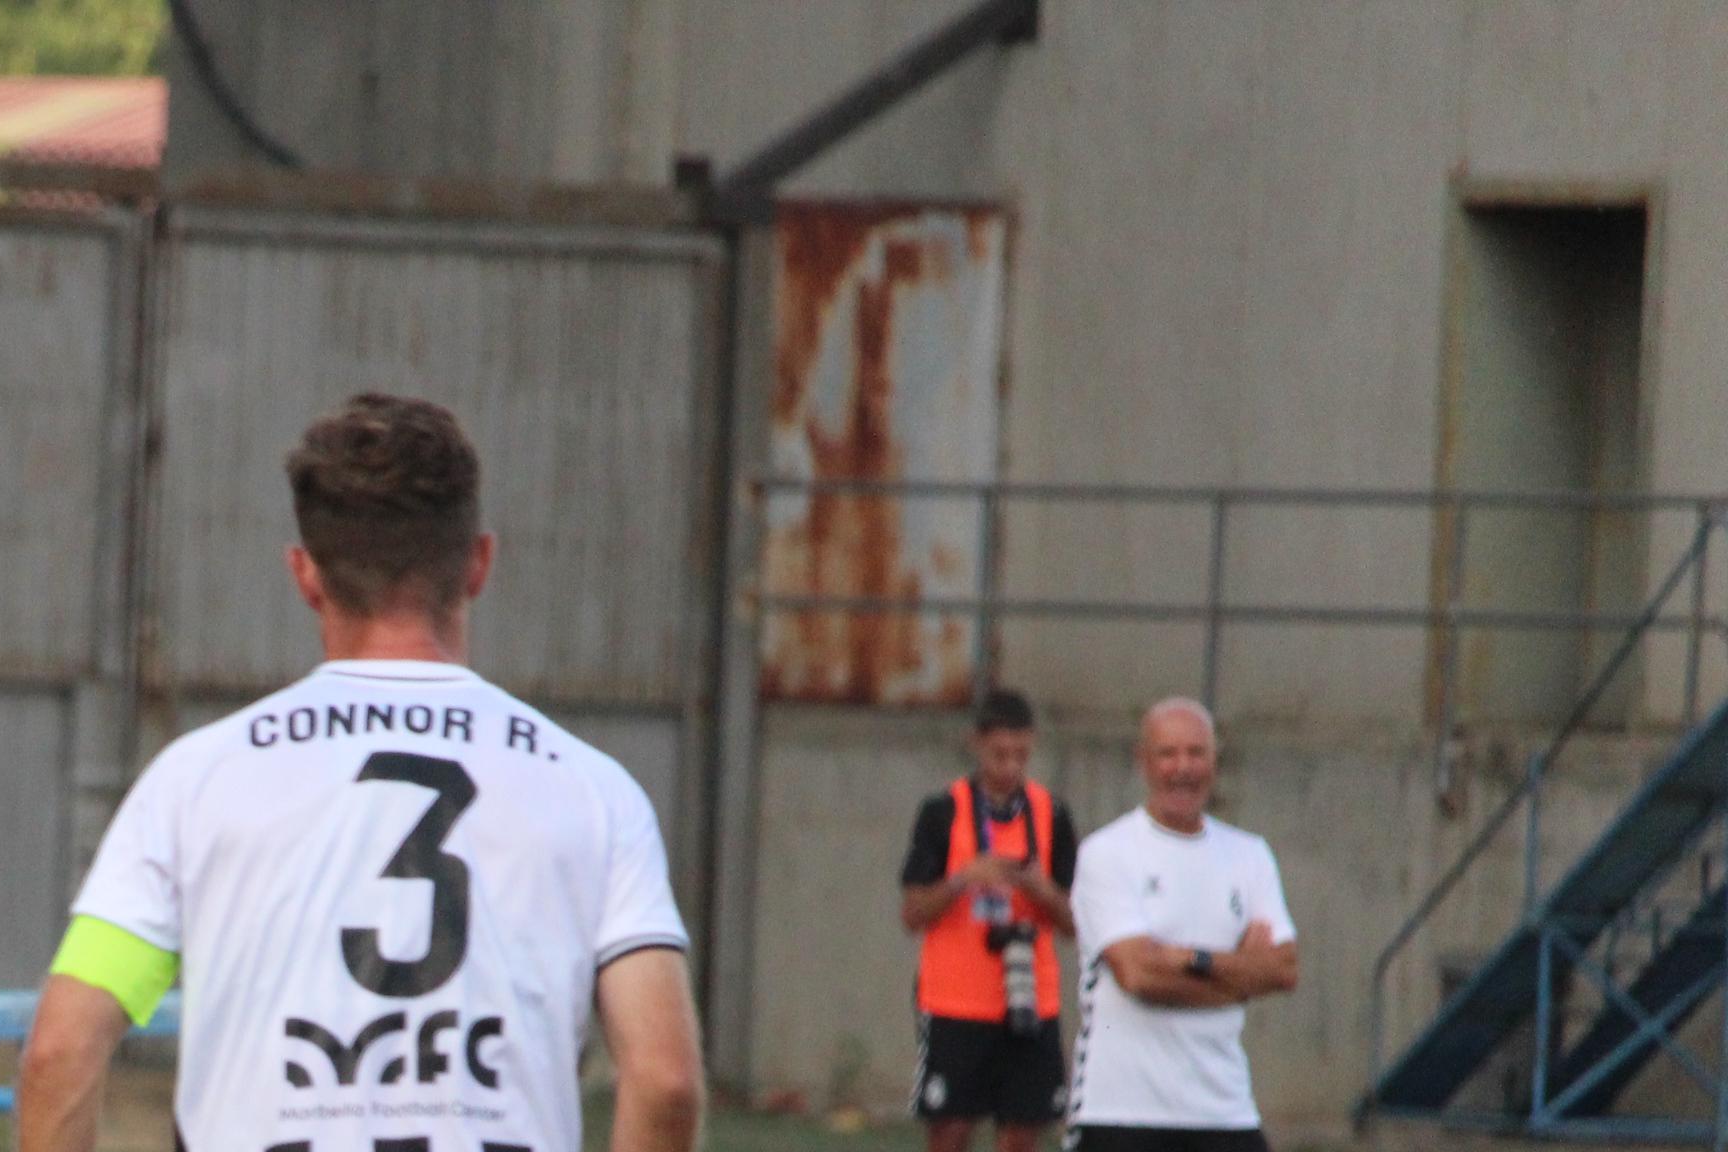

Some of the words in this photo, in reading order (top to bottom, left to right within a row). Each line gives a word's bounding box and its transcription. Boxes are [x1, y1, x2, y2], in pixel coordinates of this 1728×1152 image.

[249, 702, 476, 749] CONNOR
[507, 714, 561, 762] R.
[340, 750, 479, 999] 3
